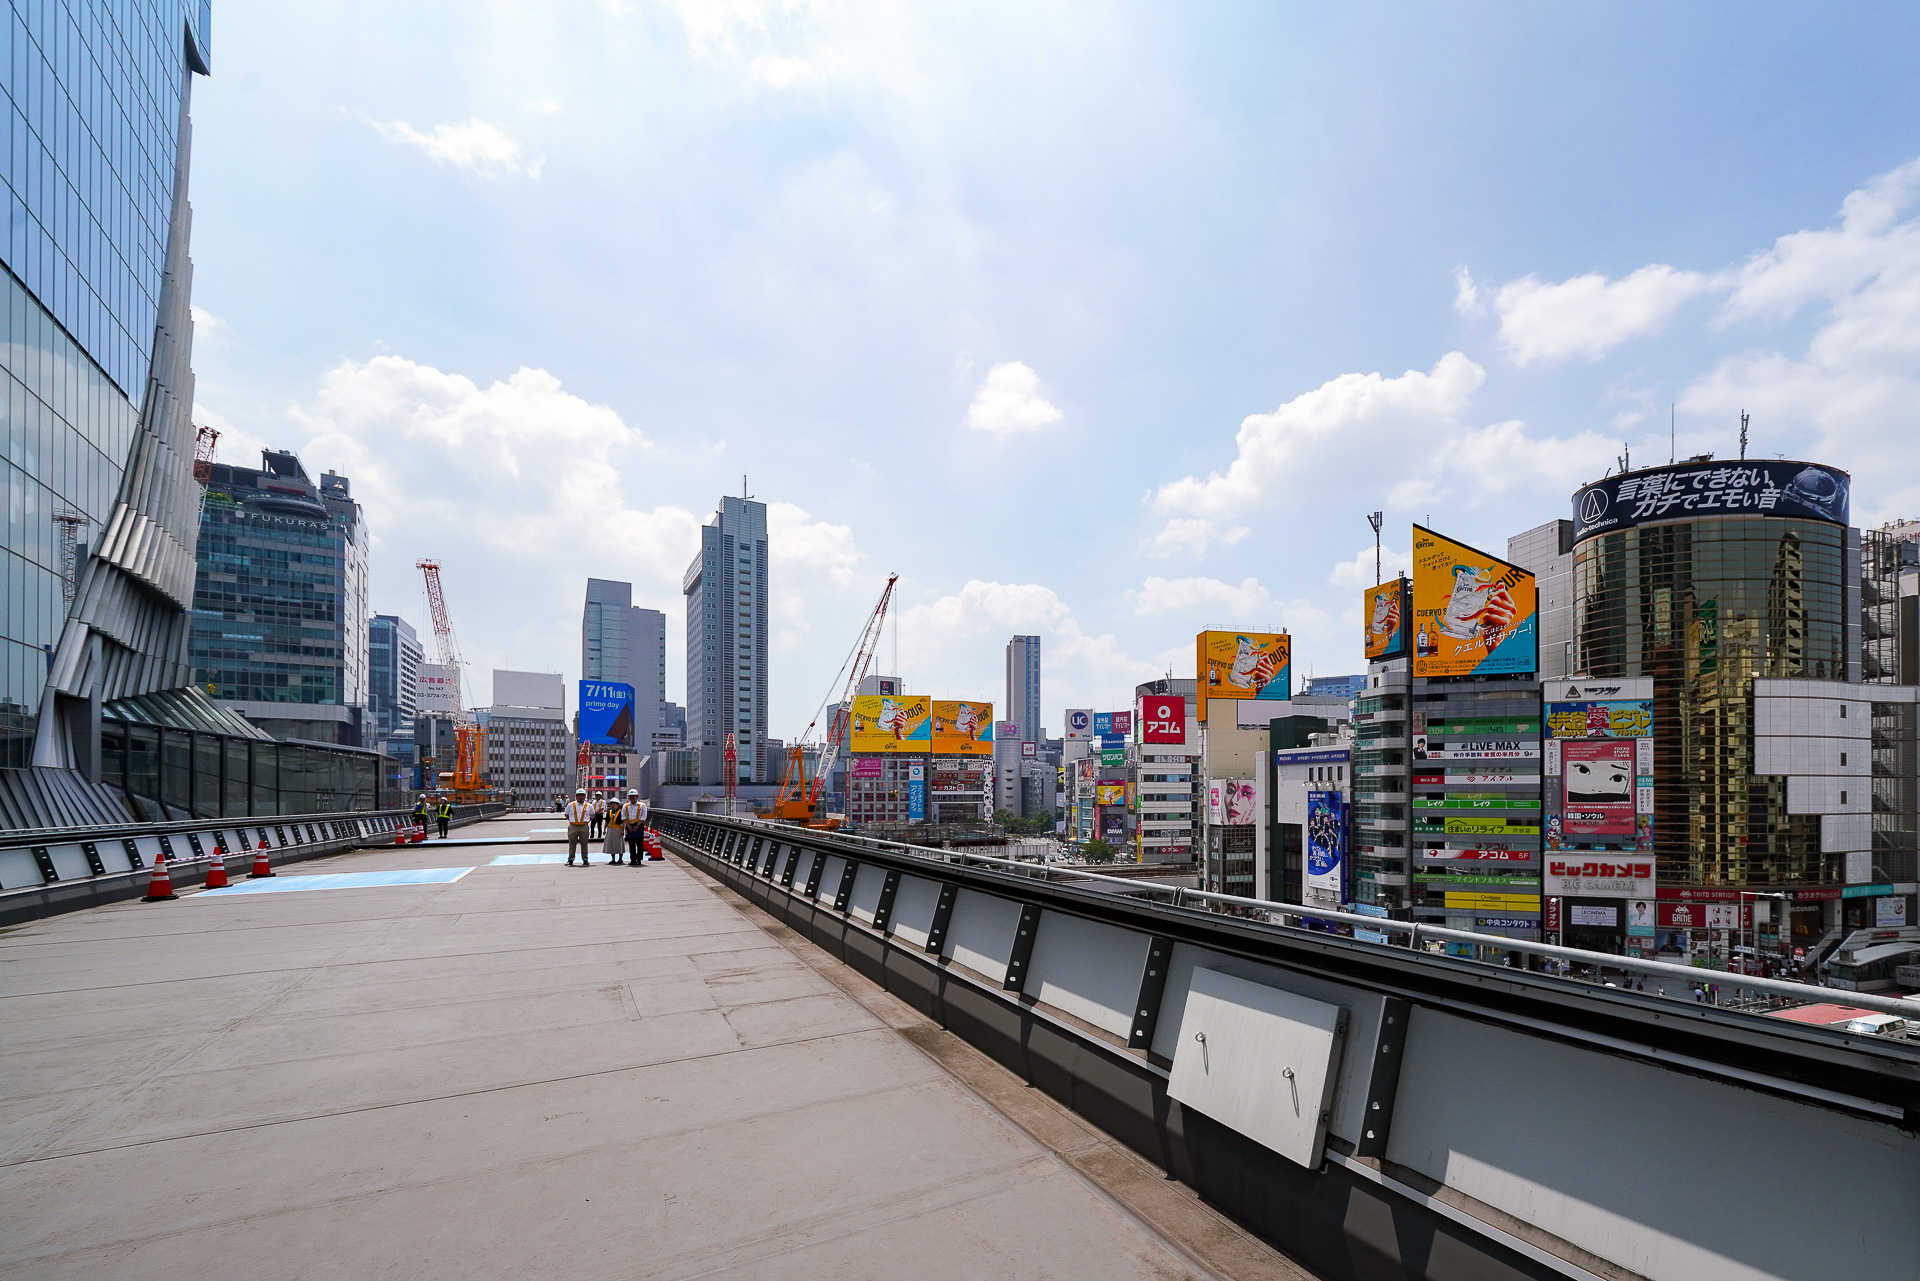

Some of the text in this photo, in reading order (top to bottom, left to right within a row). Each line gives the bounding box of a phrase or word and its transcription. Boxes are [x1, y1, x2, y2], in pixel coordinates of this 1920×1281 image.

[1616, 466, 1774, 502] 言葉にできない、
[1631, 488, 1780, 518] ガチでエモい音
[252, 514, 328, 530] FUKURAS
[1576, 518, 1618, 537] audio-technica
[1417, 609, 1441, 617] CUERVO
[586, 701, 606, 709] prime
[1072, 716, 1087, 725] UC
[1148, 721, 1180, 734] アコム
[1496, 742, 1520, 750] MAX
[1479, 851, 1509, 859] アコム
[1550, 862, 1651, 878] ビックカメラ
[1563, 880, 1637, 891] BIC CAMERA
[1487, 919, 1529, 927] 中央コンタクト
[1672, 914, 1692, 922] GAME
